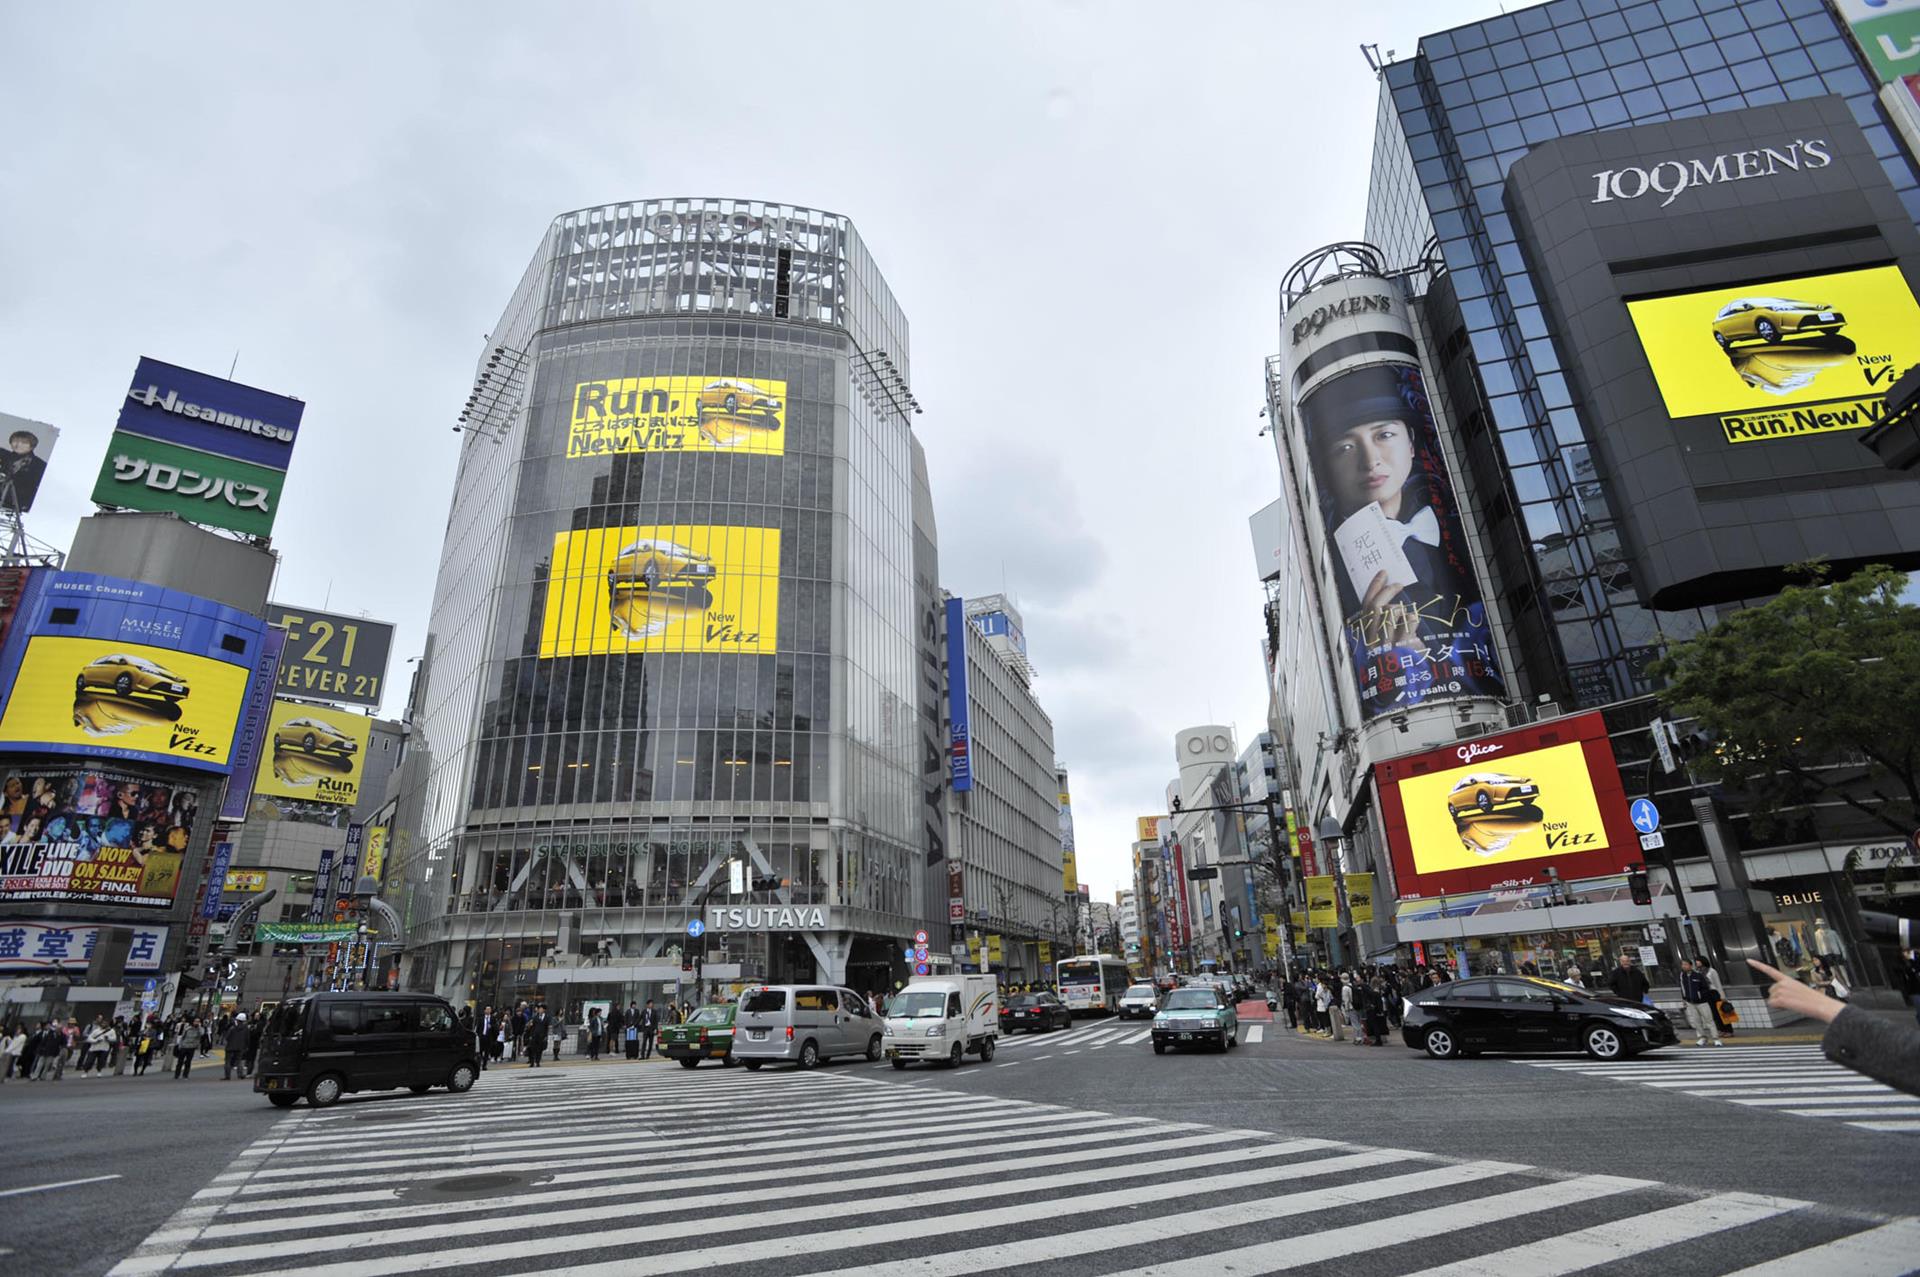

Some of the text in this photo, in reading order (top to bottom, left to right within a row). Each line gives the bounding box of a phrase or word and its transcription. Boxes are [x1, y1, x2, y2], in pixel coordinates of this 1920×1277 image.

[1591, 139, 1831, 208] 109MEN'S
[1291, 294, 1391, 347] 109MEN'S
[1857, 353, 1893, 367] New
[575, 383, 680, 420] Run,
[128, 385, 294, 443] Hisamitsu
[1723, 413, 1796, 441] Run,
[1790, 407, 1859, 432] New
[571, 428, 685, 456] New Vitz
[112, 454, 270, 514] サロンパス
[96, 584, 144, 598] Channel
[707, 610, 736, 623] New
[705, 624, 760, 644] Vitz
[352, 674, 380, 698] 21
[1406, 684, 1448, 699] tv asahi
[172, 723, 200, 736] New
[168, 733, 217, 756] Vitz
[951, 721, 968, 779] SEIBU
[1456, 743, 1504, 764] Glico
[317, 776, 357, 794] Run,
[1542, 820, 1568, 832] New
[537, 840, 739, 858] STARBUCKS COFFEE
[1545, 831, 1598, 850] Vitz
[46, 842, 80, 859] LIVE
[97, 846, 133, 864] NOW
[40, 860, 75, 877] DVD
[74, 862, 99, 879] ON
[70, 879, 138, 893] 9.27 FINAL
[712, 907, 826, 929] TSUTAYA
